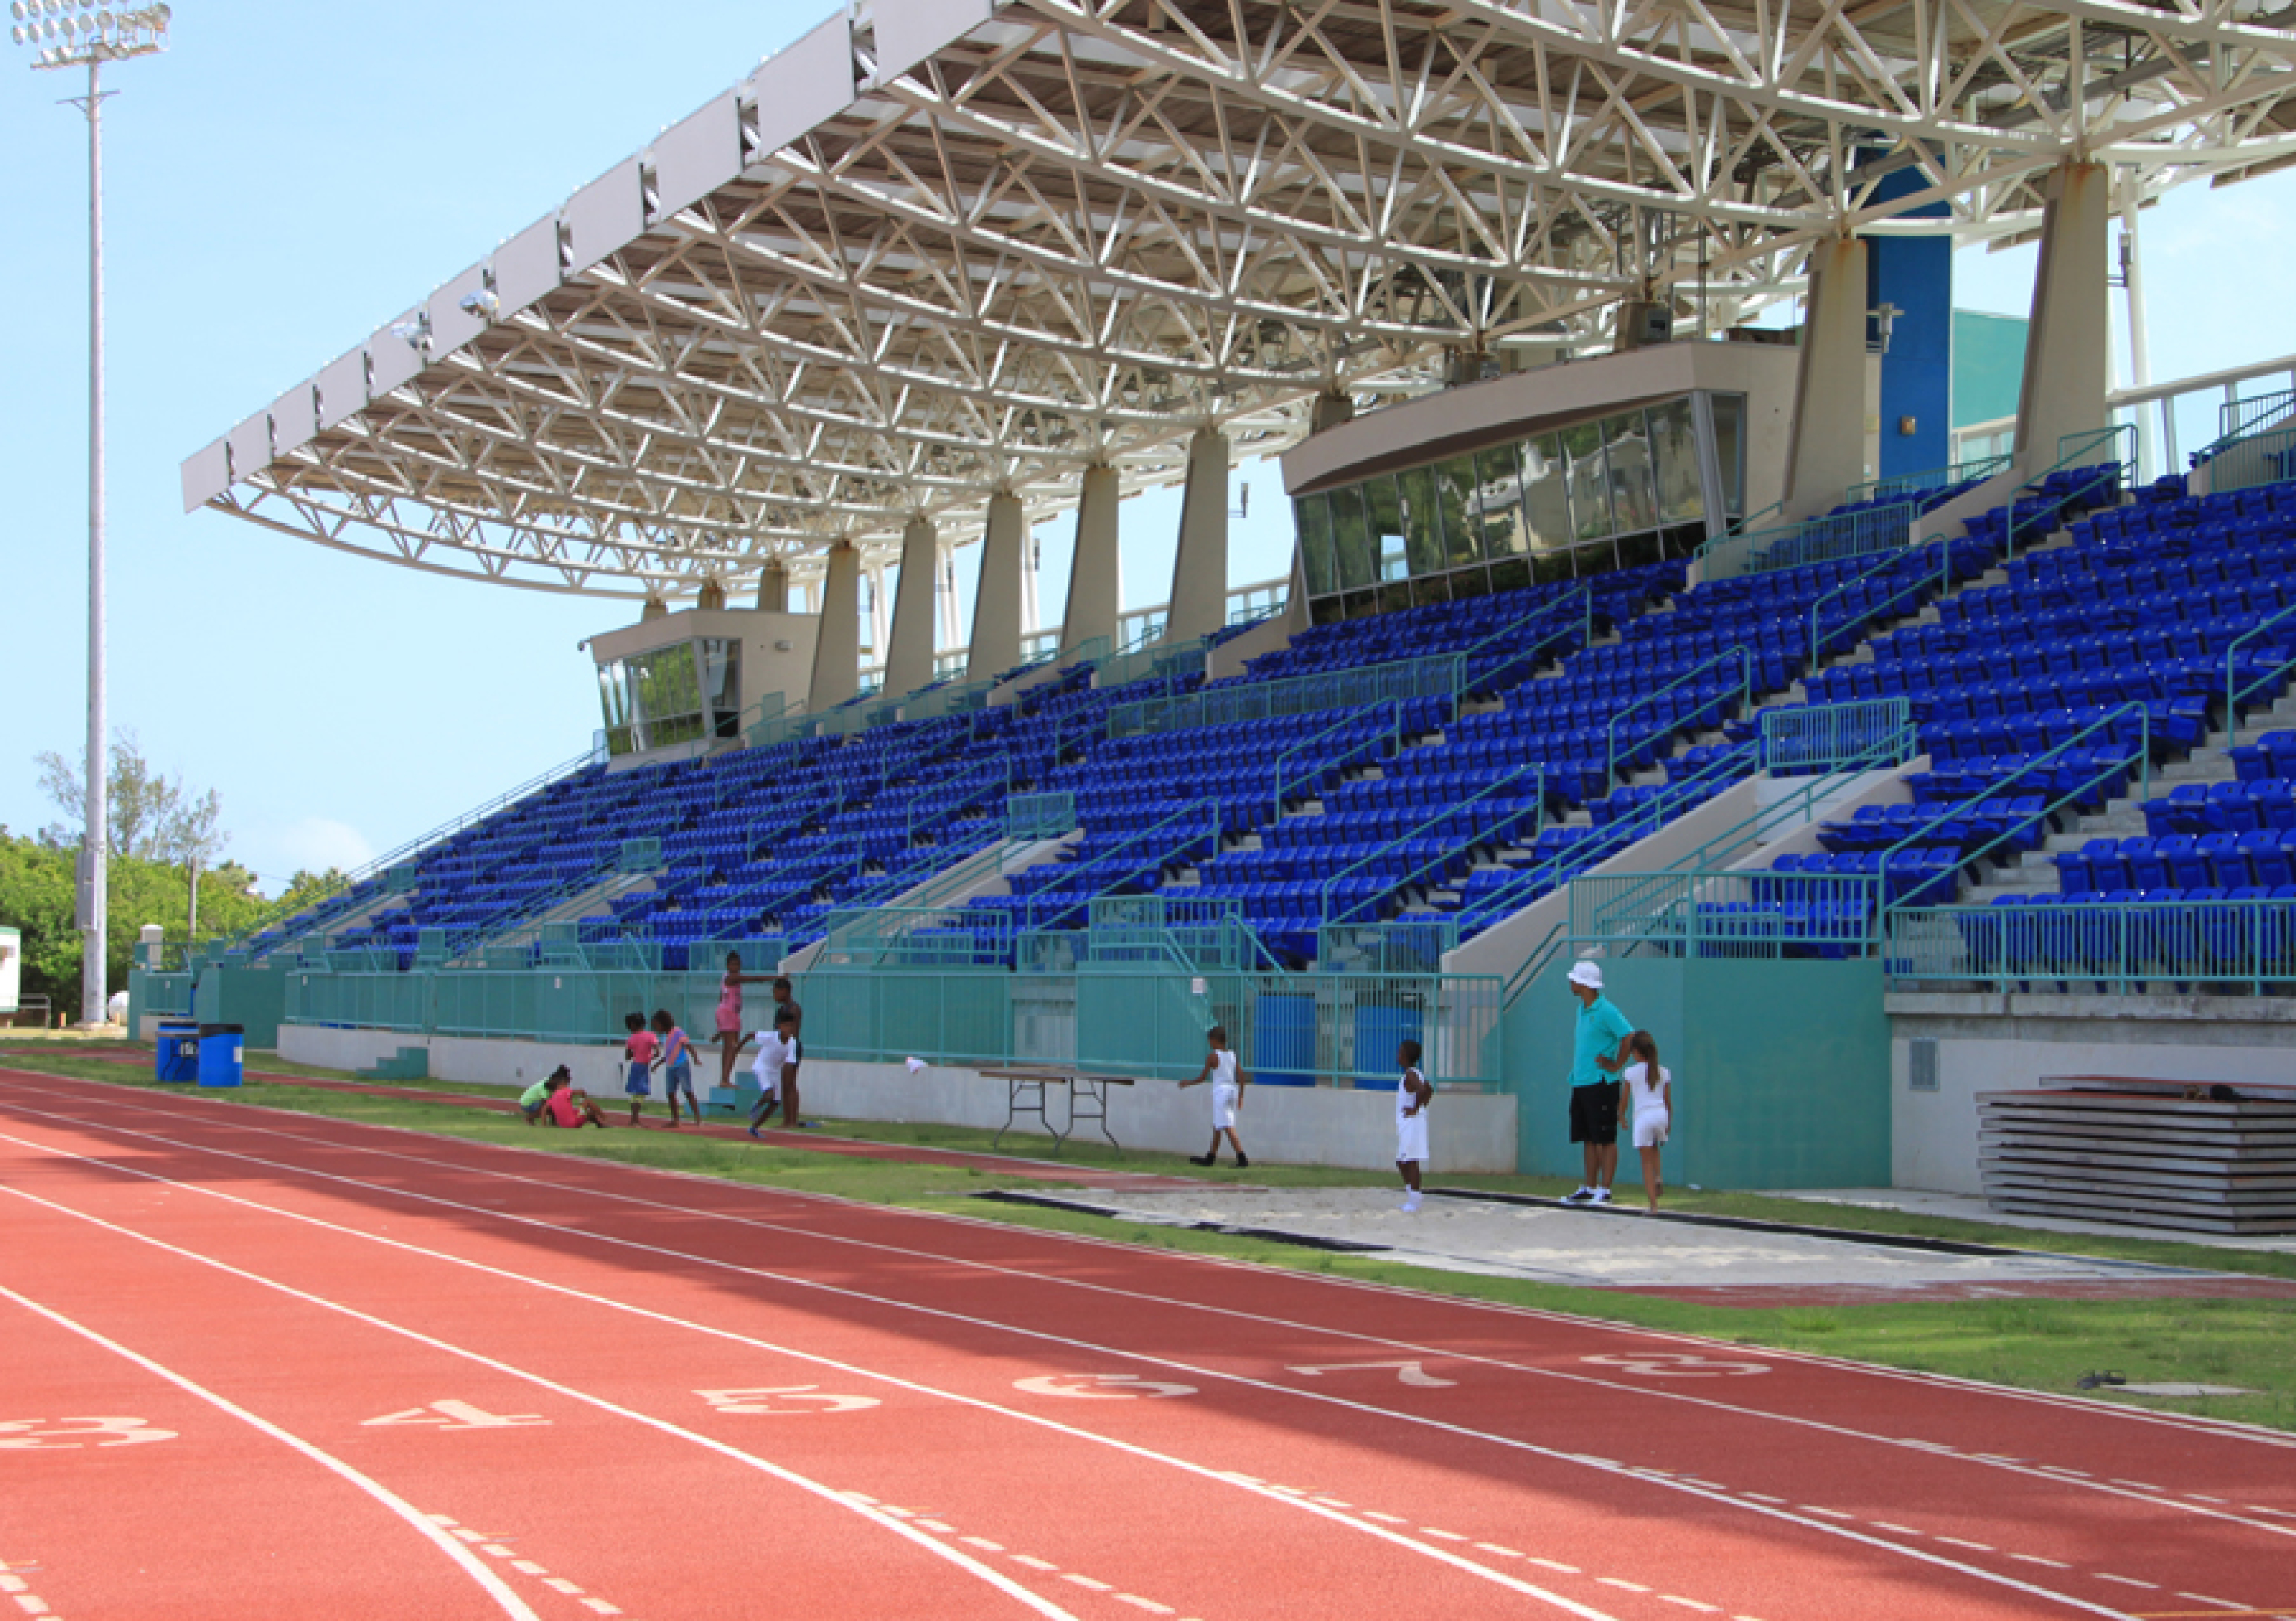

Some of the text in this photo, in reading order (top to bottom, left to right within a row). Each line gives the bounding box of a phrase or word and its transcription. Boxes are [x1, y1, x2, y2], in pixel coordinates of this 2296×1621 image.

[1284, 1361, 1460, 1388] 7
[1578, 1352, 1773, 1377] 8
[691, 1384, 883, 1415] 5
[1012, 1373, 1199, 1401] 6
[359, 1399, 552, 1431] 4
[0, 1415, 181, 1449] 3
